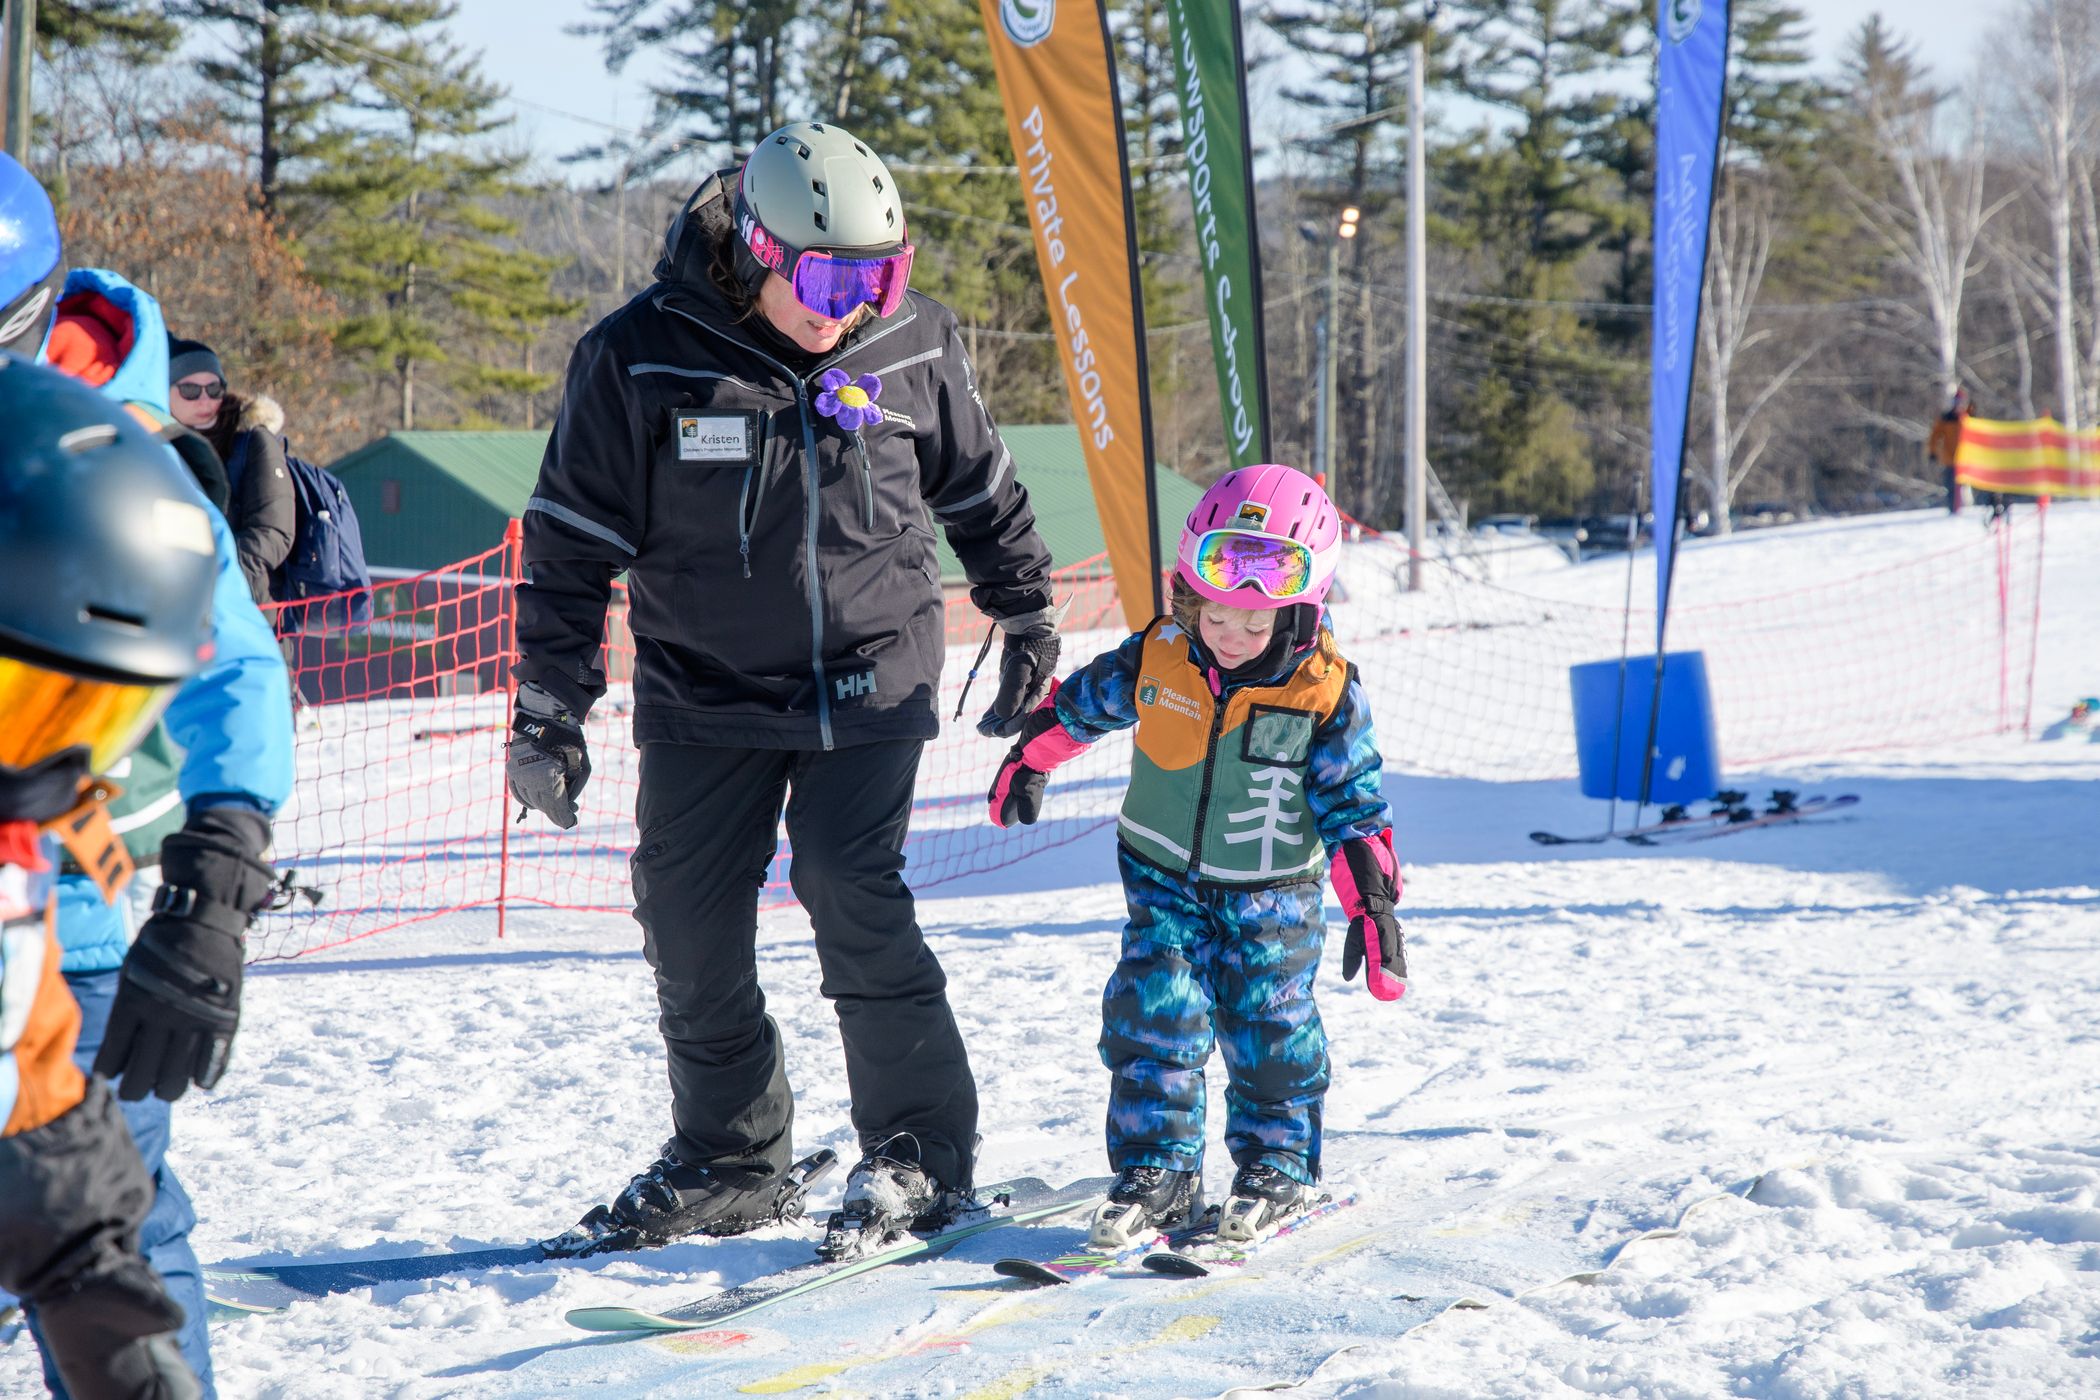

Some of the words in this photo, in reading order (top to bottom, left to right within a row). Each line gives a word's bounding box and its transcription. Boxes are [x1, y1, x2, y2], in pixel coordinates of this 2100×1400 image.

[1021, 105, 1066, 269] Private
[1058, 271, 1115, 452] Lessons
[701, 434, 740, 445] Kristen
[836, 671, 877, 700] HH
[1159, 696, 1202, 721] Mountain
[1162, 687, 1201, 710] Pleasant
